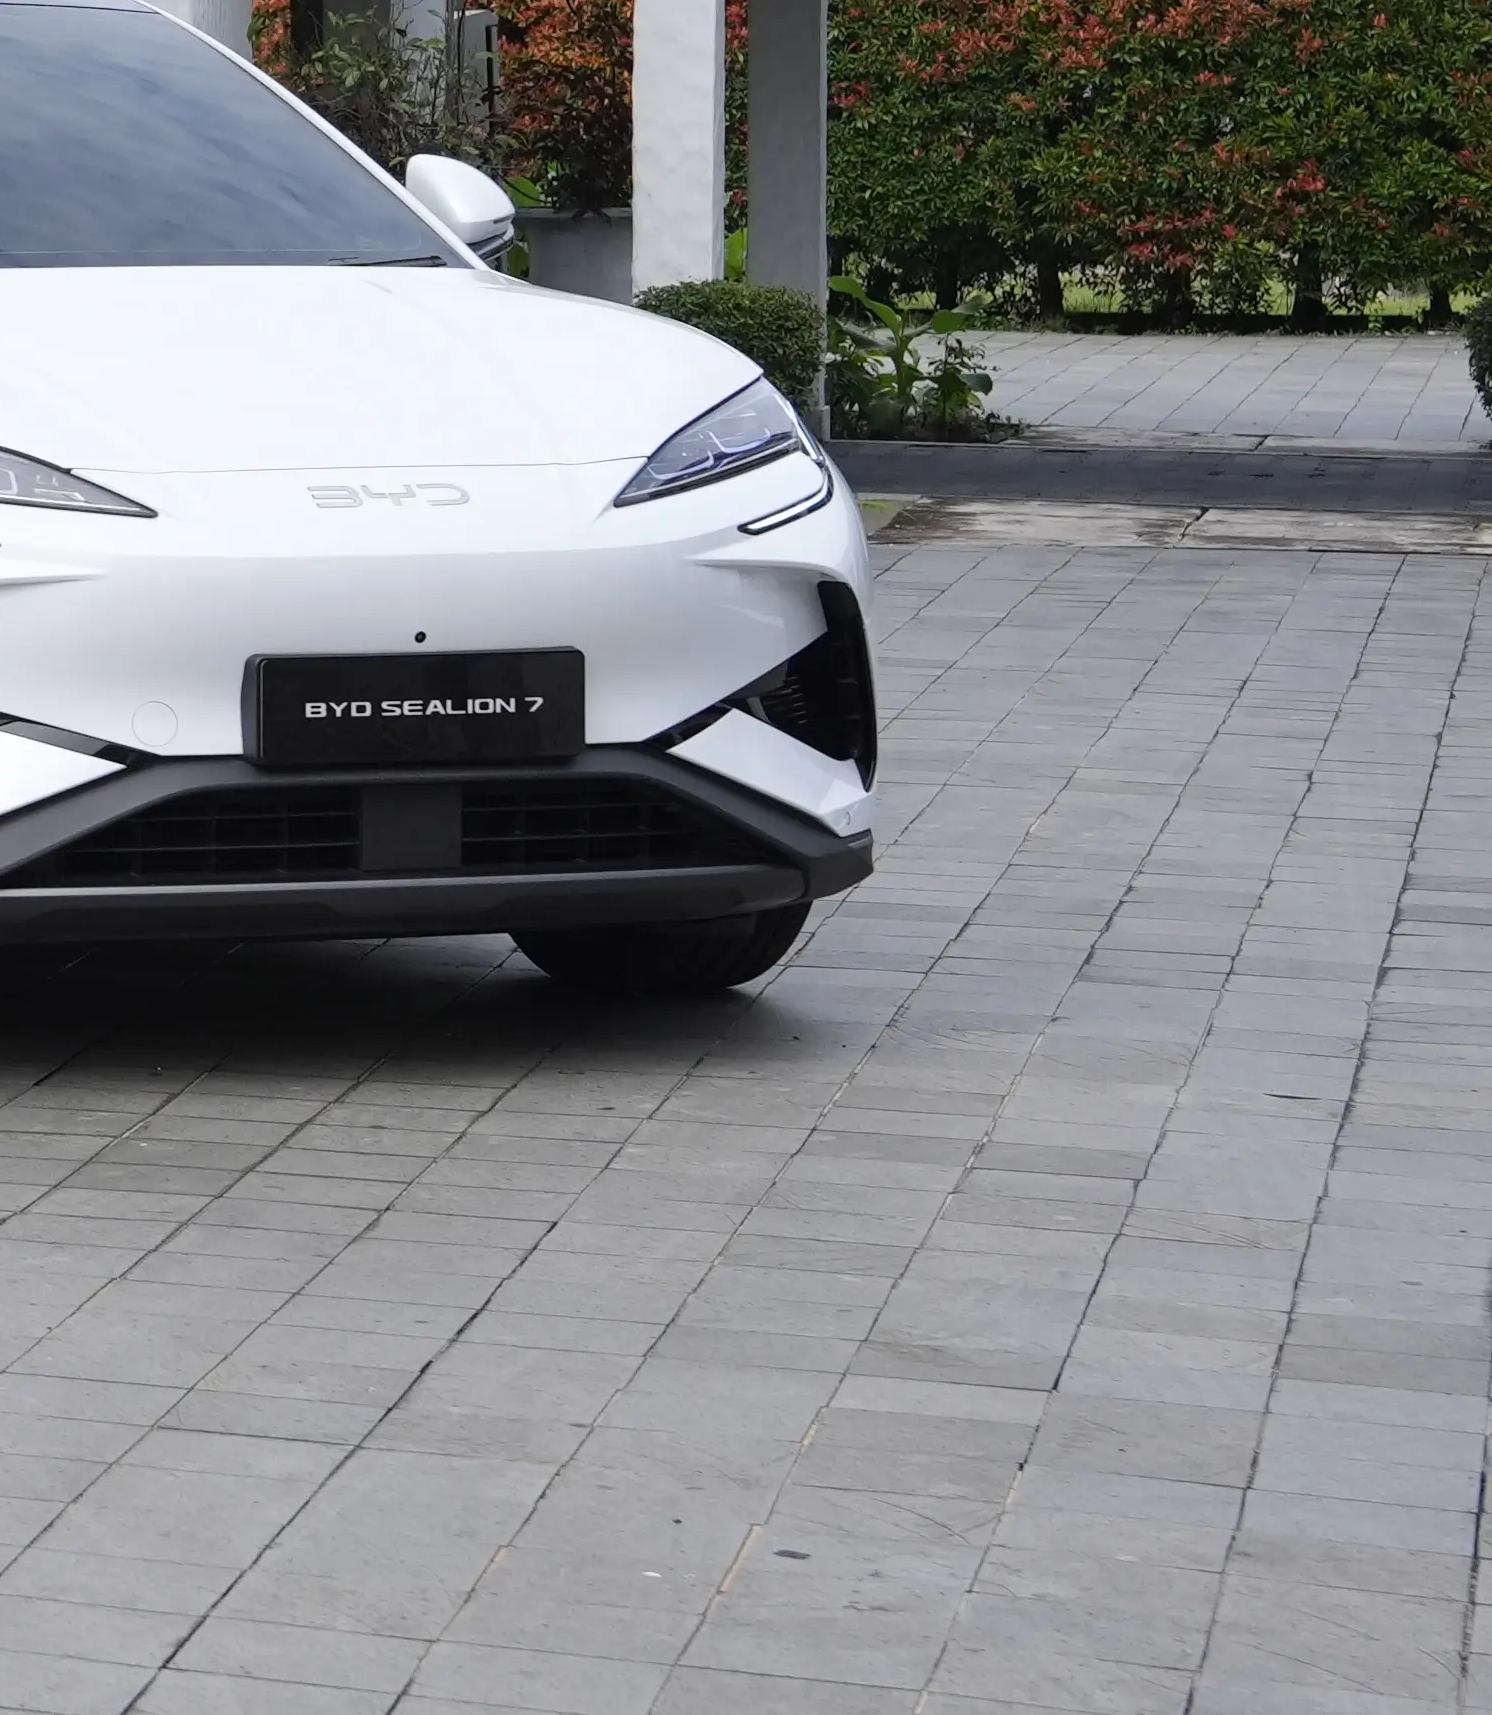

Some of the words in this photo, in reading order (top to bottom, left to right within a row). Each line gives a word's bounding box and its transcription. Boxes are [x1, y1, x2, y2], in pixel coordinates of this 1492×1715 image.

[306, 482, 470, 508] BYD
[305, 701, 373, 718] BYD
[380, 697, 517, 716] SEALION
[524, 696, 544, 713] 7
